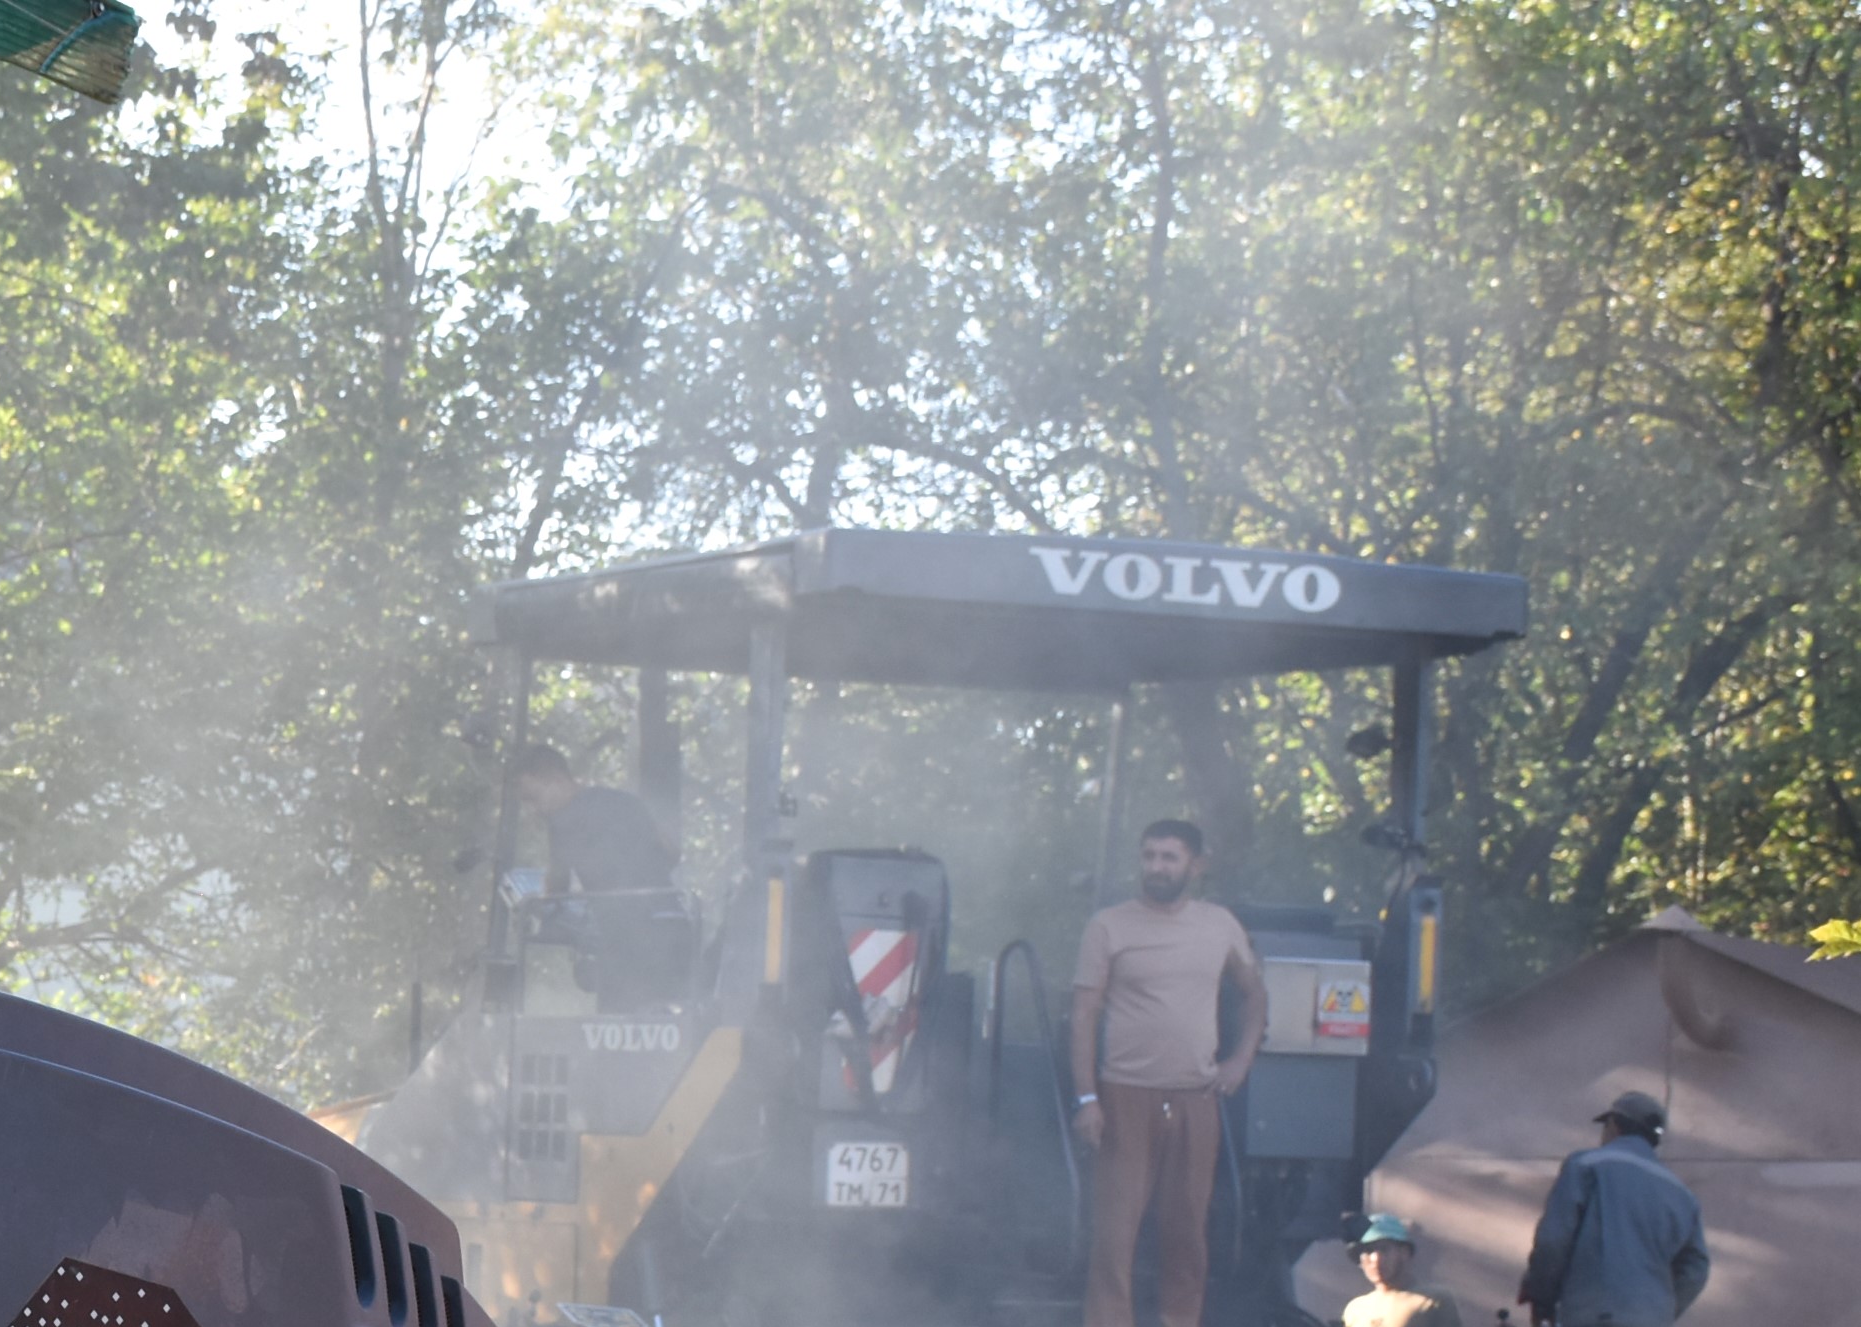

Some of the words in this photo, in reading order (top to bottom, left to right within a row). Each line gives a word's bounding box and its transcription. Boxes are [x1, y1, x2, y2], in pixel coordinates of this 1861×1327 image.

[1028, 547, 1341, 613] VOLVO
[581, 1023, 680, 1051] VOLVO
[838, 1146, 899, 1173] 4767
[878, 1181, 901, 1203] 71
